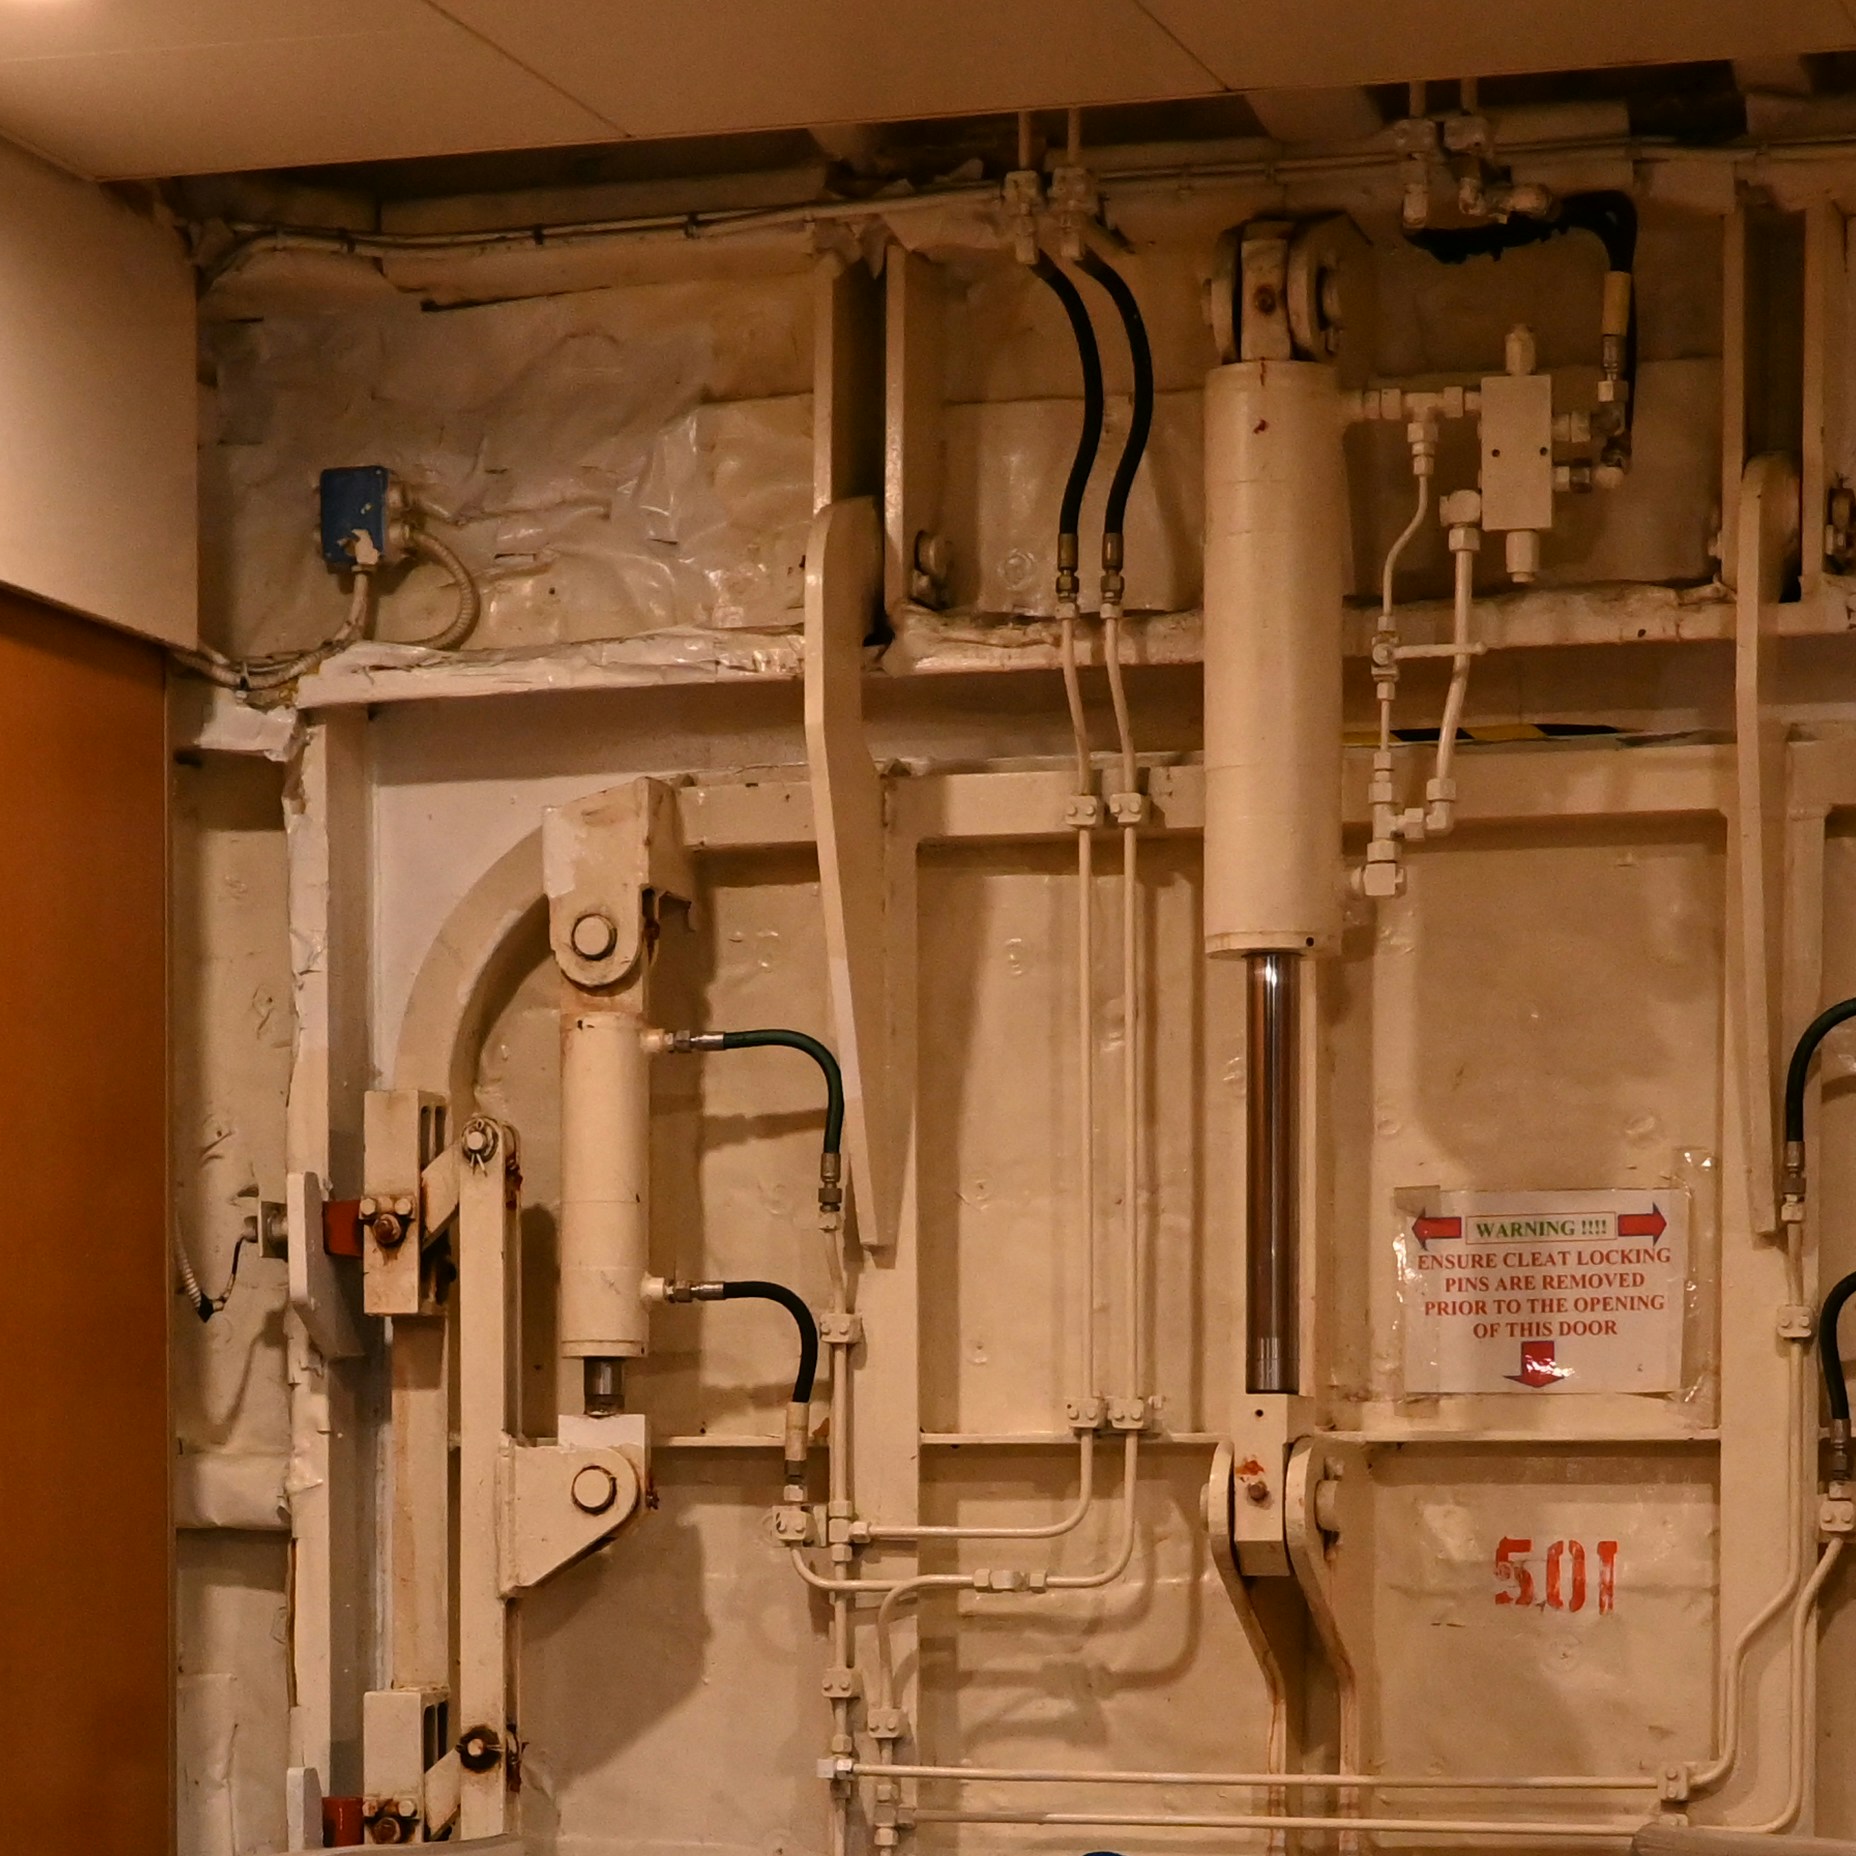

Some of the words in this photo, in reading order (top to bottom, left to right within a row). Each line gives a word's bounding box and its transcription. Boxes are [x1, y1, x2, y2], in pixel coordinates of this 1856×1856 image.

[1476, 1220, 1576, 1238] WARNING
[1581, 1218, 1607, 1236] !!!!
[1417, 1253, 1497, 1271] ENSURE
[1502, 1251, 1571, 1269] CLEAT
[1577, 1247, 1672, 1266] LOCKING
[1445, 1276, 1490, 1293] PINS
[1495, 1275, 1536, 1291] ARE
[1542, 1272, 1645, 1290] REMOVED
[1424, 1300, 1488, 1316] PRIOR
[1493, 1299, 1521, 1315] TO
[1526, 1298, 1567, 1314] THE
[1573, 1295, 1665, 1312] OPENING
[1473, 1323, 1501, 1339] OF
[1506, 1321, 1553, 1338] THIS
[1558, 1319, 1618, 1336] DOOR
